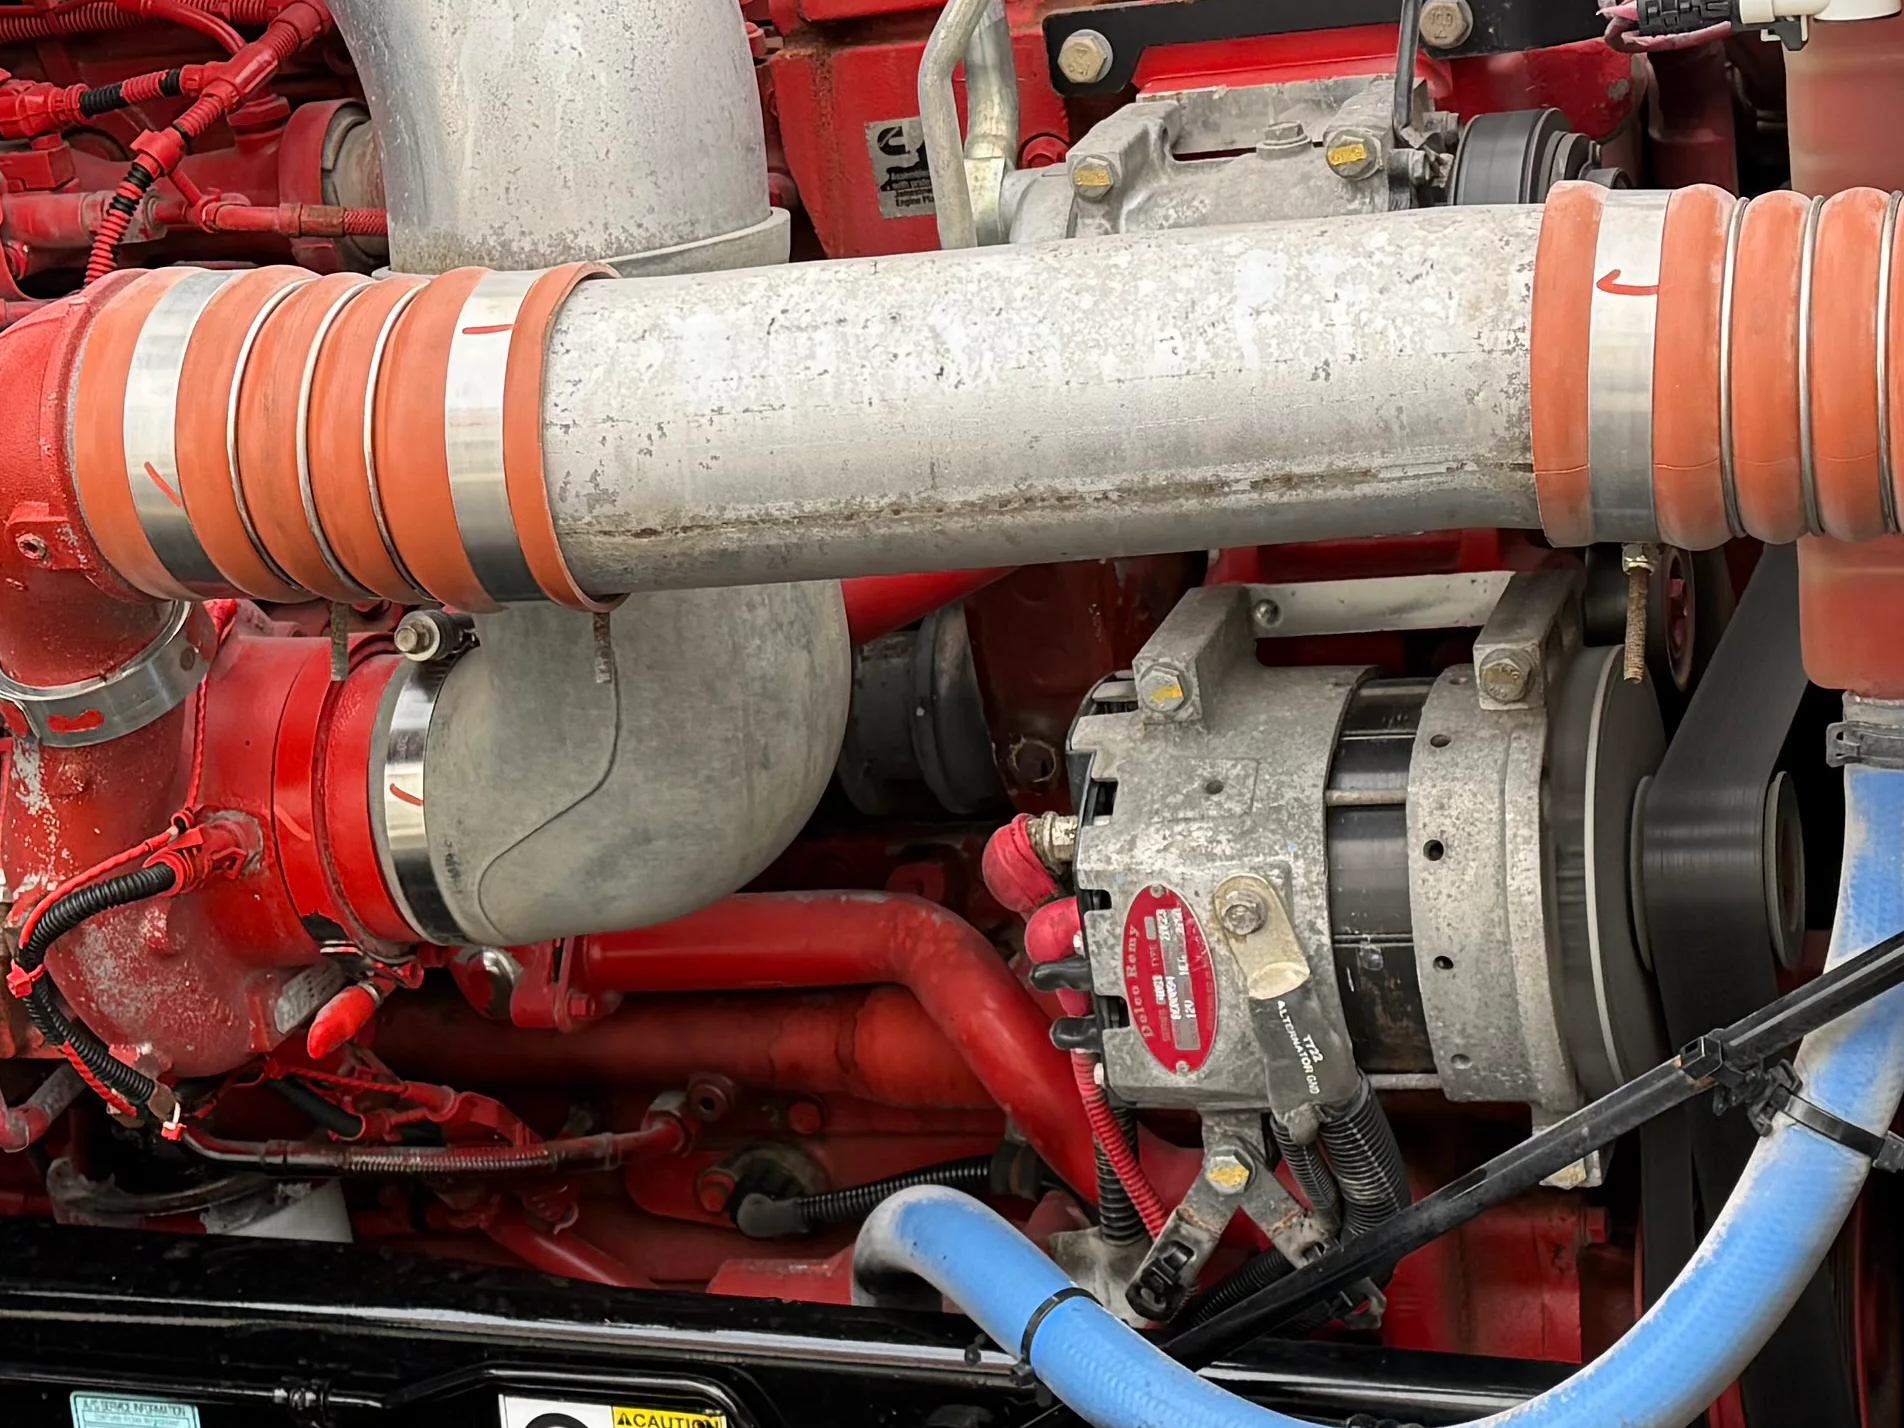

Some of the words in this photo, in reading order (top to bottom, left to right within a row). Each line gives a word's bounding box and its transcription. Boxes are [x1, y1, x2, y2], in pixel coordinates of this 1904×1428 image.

[1126, 925, 1141, 978] Remy
[1132, 985, 1154, 1040] Delco
[1277, 1000, 1314, 1073] ALTERNATOR
[1306, 1073, 1320, 1094] GND
[1303, 1034, 1324, 1063] T722
